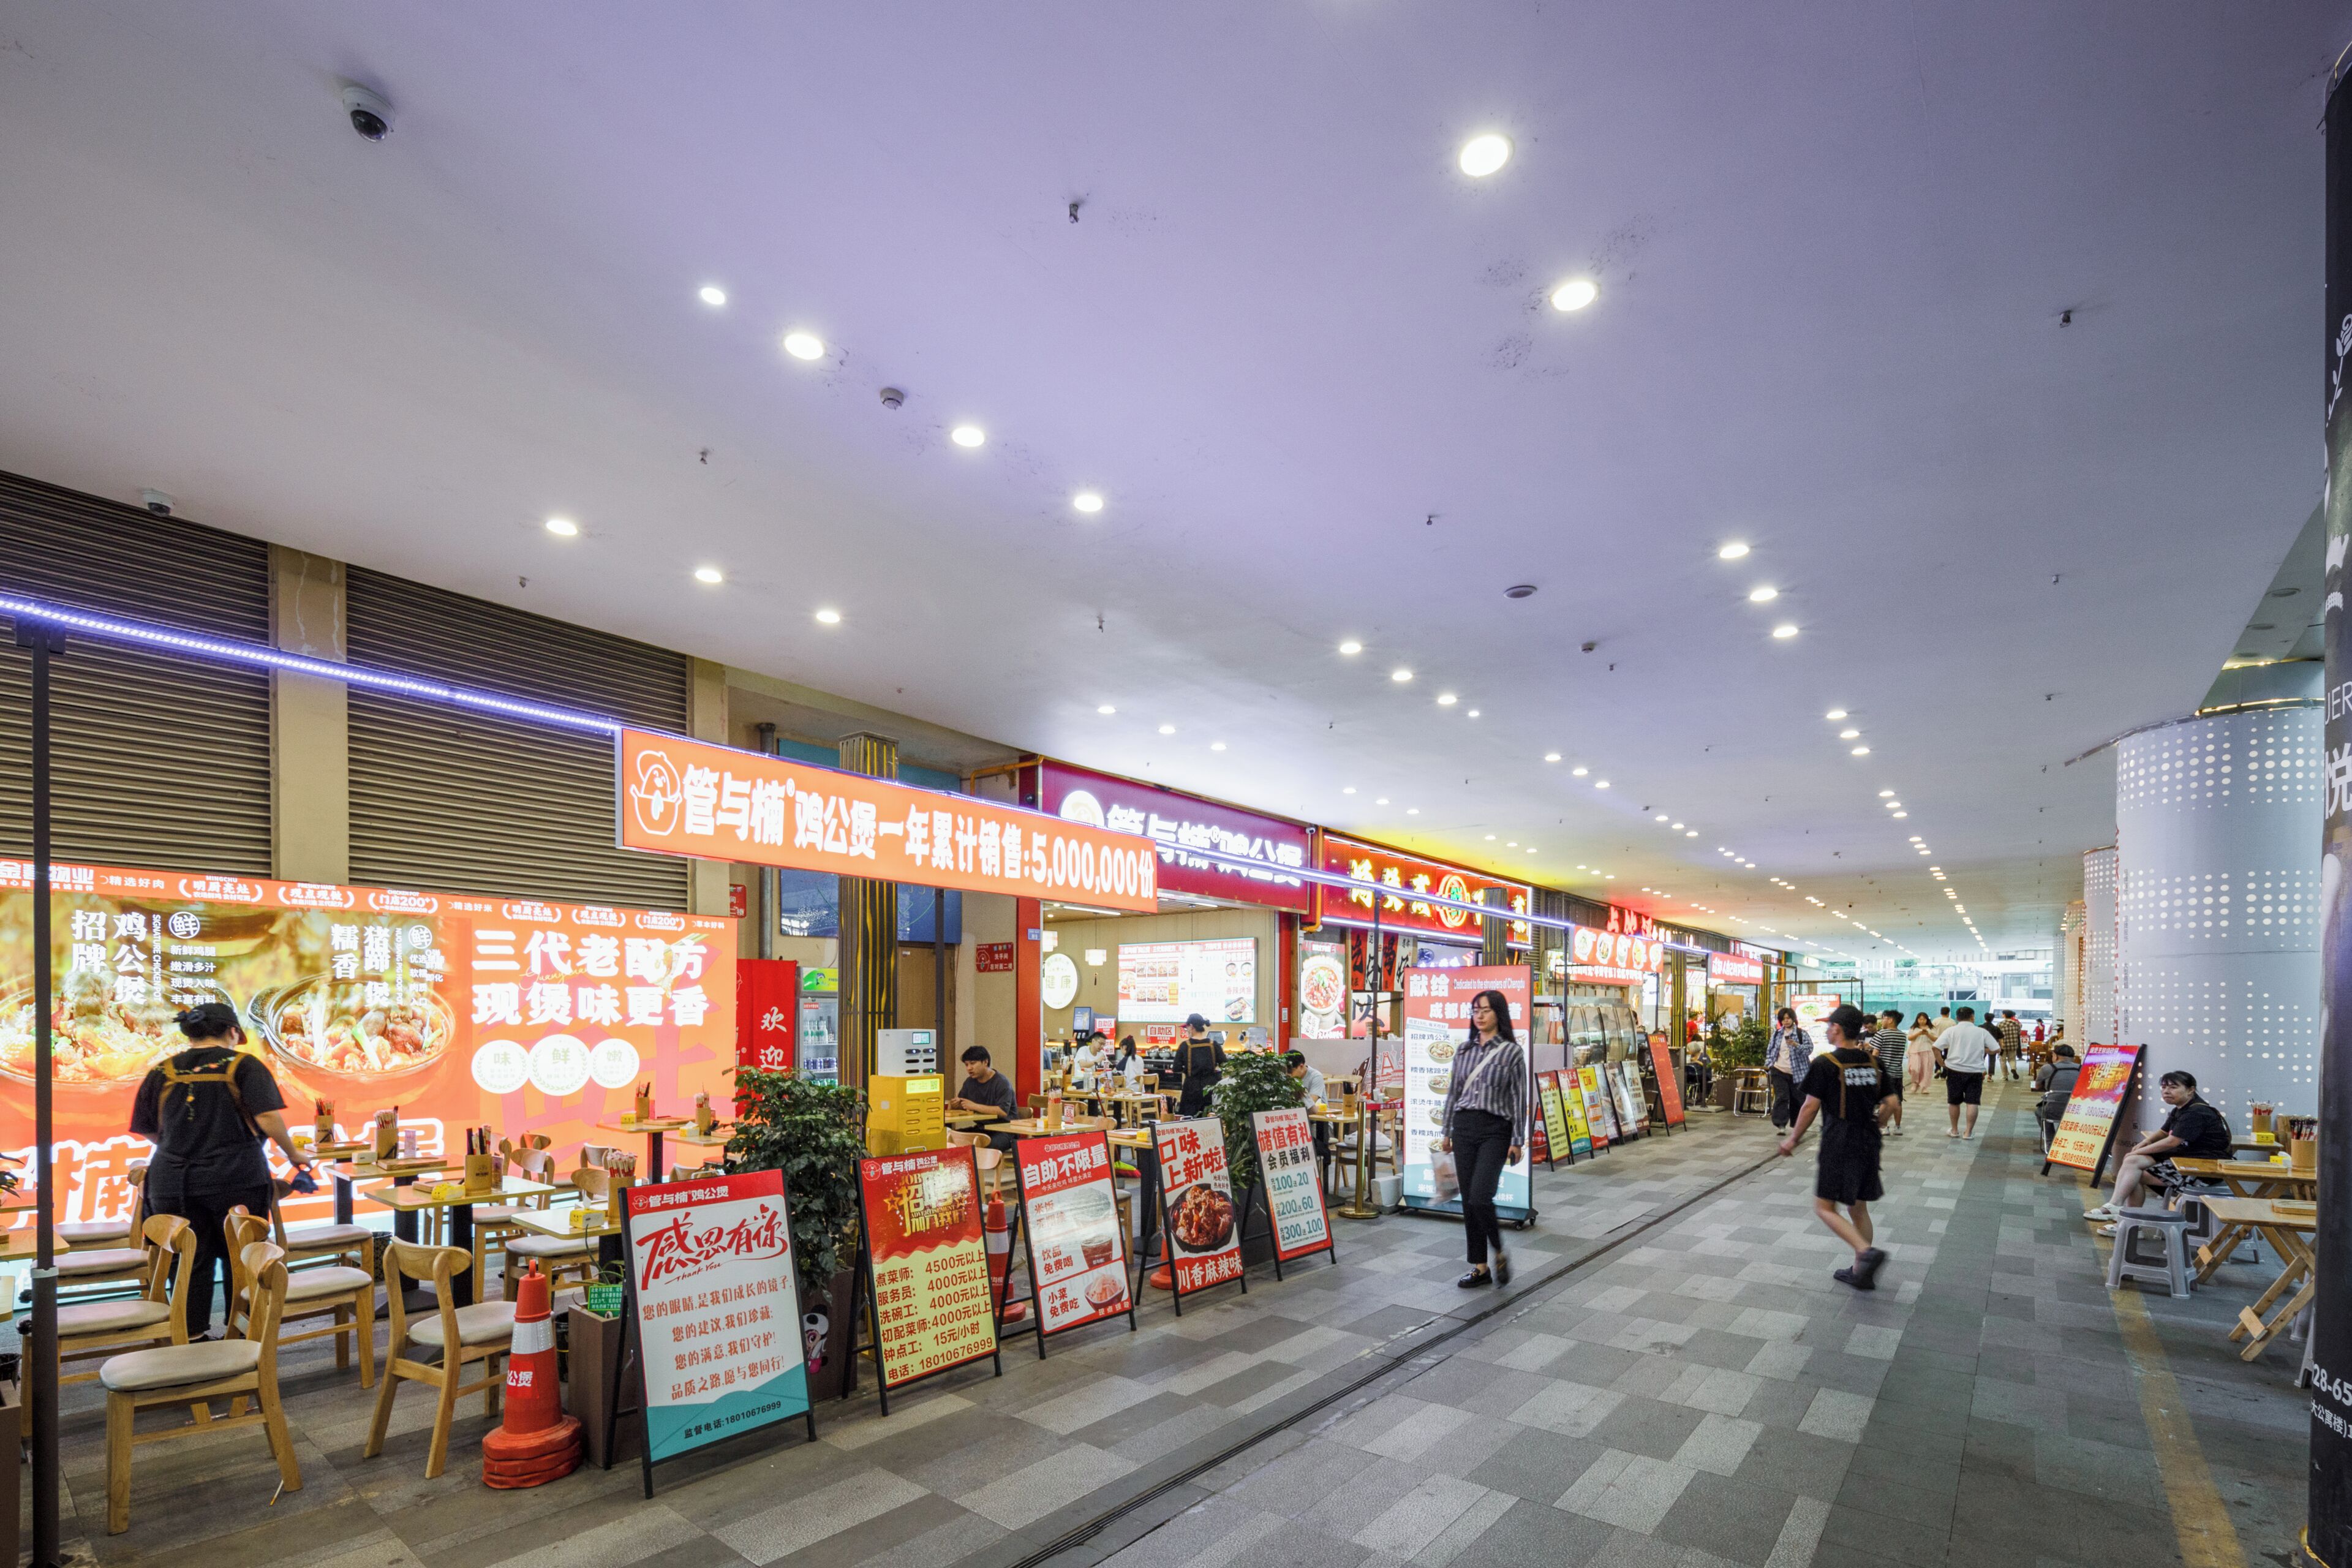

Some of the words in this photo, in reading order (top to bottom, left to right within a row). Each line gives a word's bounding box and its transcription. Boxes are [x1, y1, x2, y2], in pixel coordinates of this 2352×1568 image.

[109, 876, 165, 889] 精选好肉
[290, 888, 344, 901] 现点现做
[453, 902, 492, 913] 精选好米
[153, 914, 161, 954] SIGNATURE
[172, 915, 198, 937] 鲜
[170, 945, 216, 957] 新鲜鸡腿
[472, 929, 707, 979] 三代老配方
[153, 956, 161, 986] CHICKEN
[170, 961, 216, 973] 嫩滑多汁
[171, 978, 216, 989] 现煲入味
[1045, 975, 1071, 989] 健康
[1410, 974, 1449, 997] 献给
[153, 987, 161, 1002] POT
[171, 995, 216, 1005] 丰富有料
[471, 982, 709, 1027] 现煲味更香
[1430, 1002, 1522, 1020] 成都的者
[760, 1006, 787, 1070] 欢迎
[1150, 1026, 1173, 1036] 自助区
[1257, 1121, 1312, 1153] 储值有礼
[1411, 1129, 1446, 1137] 香糯鸡爪
[1158, 1129, 1201, 1165] 口味
[1267, 1146, 1310, 1170] 会员福利
[1023, 1143, 1108, 1189] 自助不限量
[900, 1173, 922, 1186] JOB
[636, 1210, 788, 1291] 感恩有你
[1042, 1245, 1062, 1262] 饮品
[925, 1250, 986, 1275] 4500元以上
[1044, 1255, 1074, 1277] 免费喝
[1177, 1251, 1243, 1291] 川香麻辣味
[877, 1285, 916, 1306] 服务员：
[927, 1266, 987, 1292] 4000元以上
[1048, 1287, 1068, 1305] 小菜
[880, 1304, 918, 1325] 洗碗工：
[930, 1283, 989, 1310] 4000元以上
[1049, 1298, 1080, 1320] 免费吃
[884, 1341, 922, 1363] 钟点工：
[933, 1321, 980, 1346] 15元/小时
[919, 1336, 993, 1370] 18010676999
